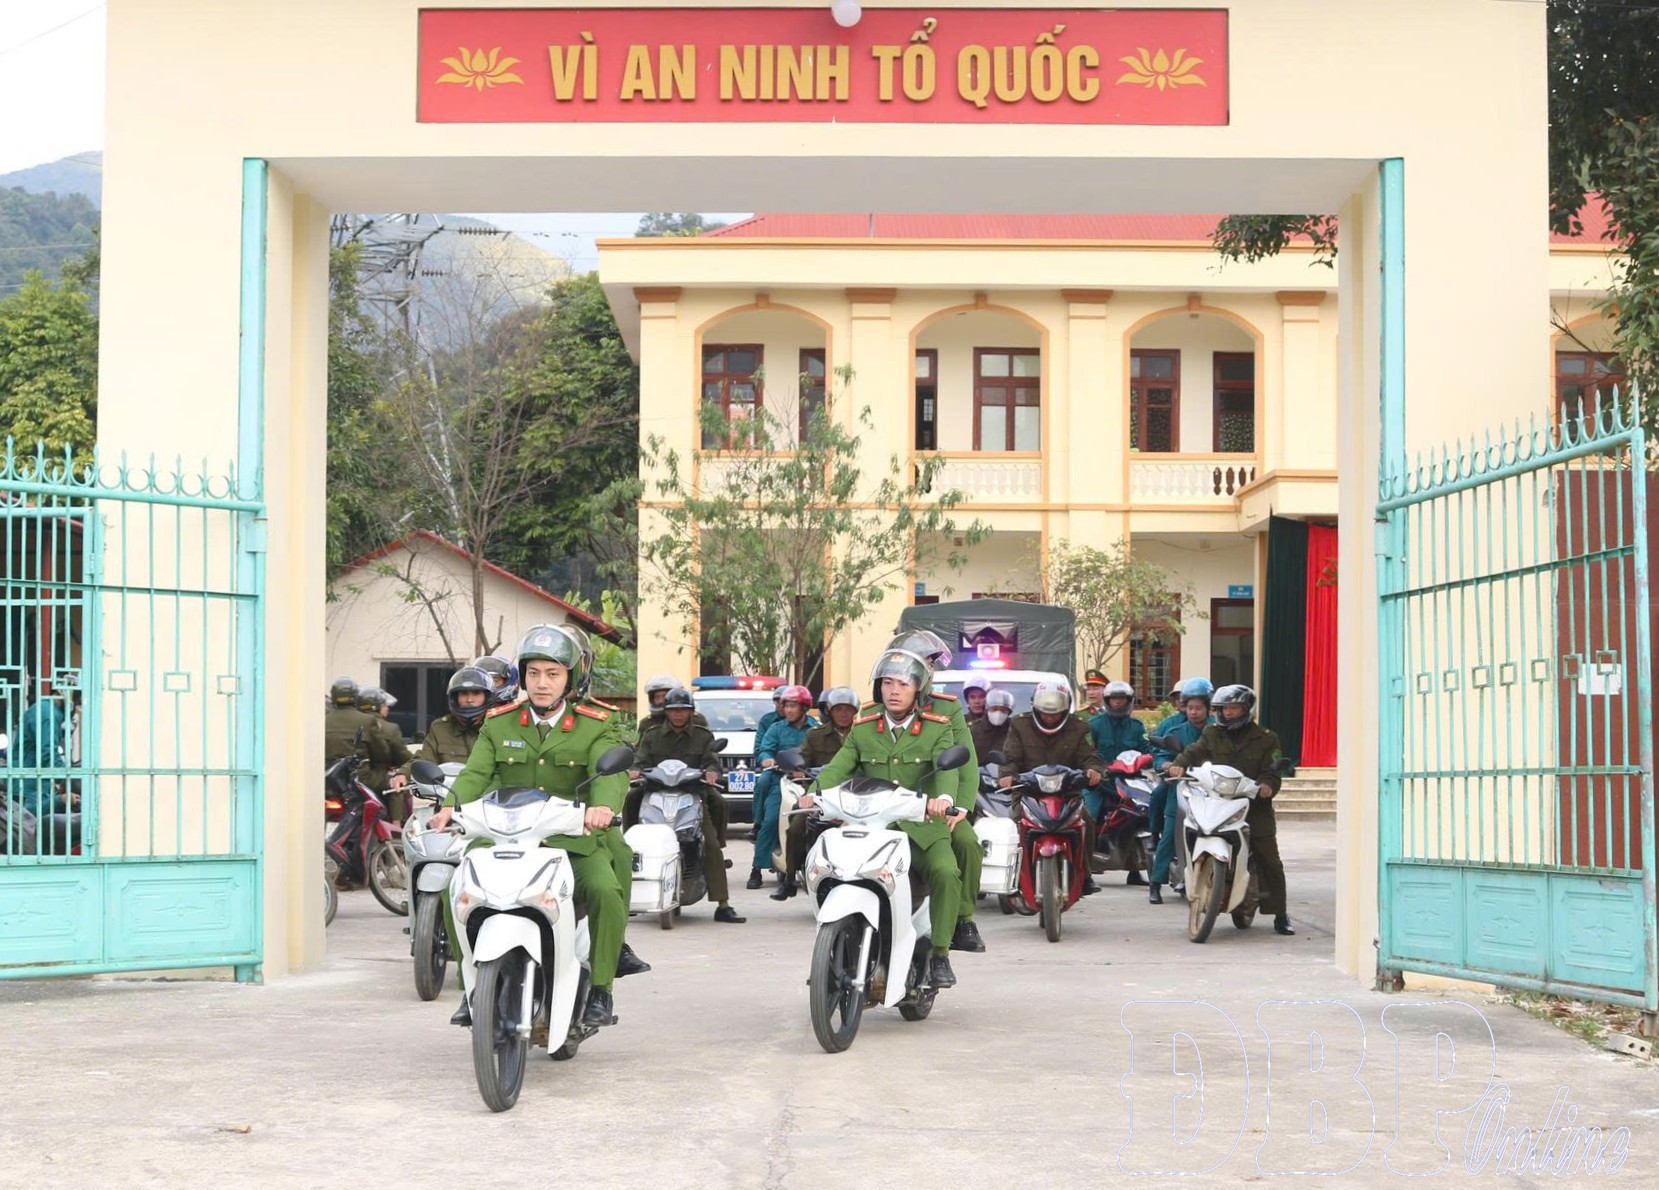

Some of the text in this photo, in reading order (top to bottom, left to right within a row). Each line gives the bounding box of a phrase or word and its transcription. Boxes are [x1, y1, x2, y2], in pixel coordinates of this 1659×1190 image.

[548, 17, 1101, 108] VÌ AN NINH TỔ QUỐC
